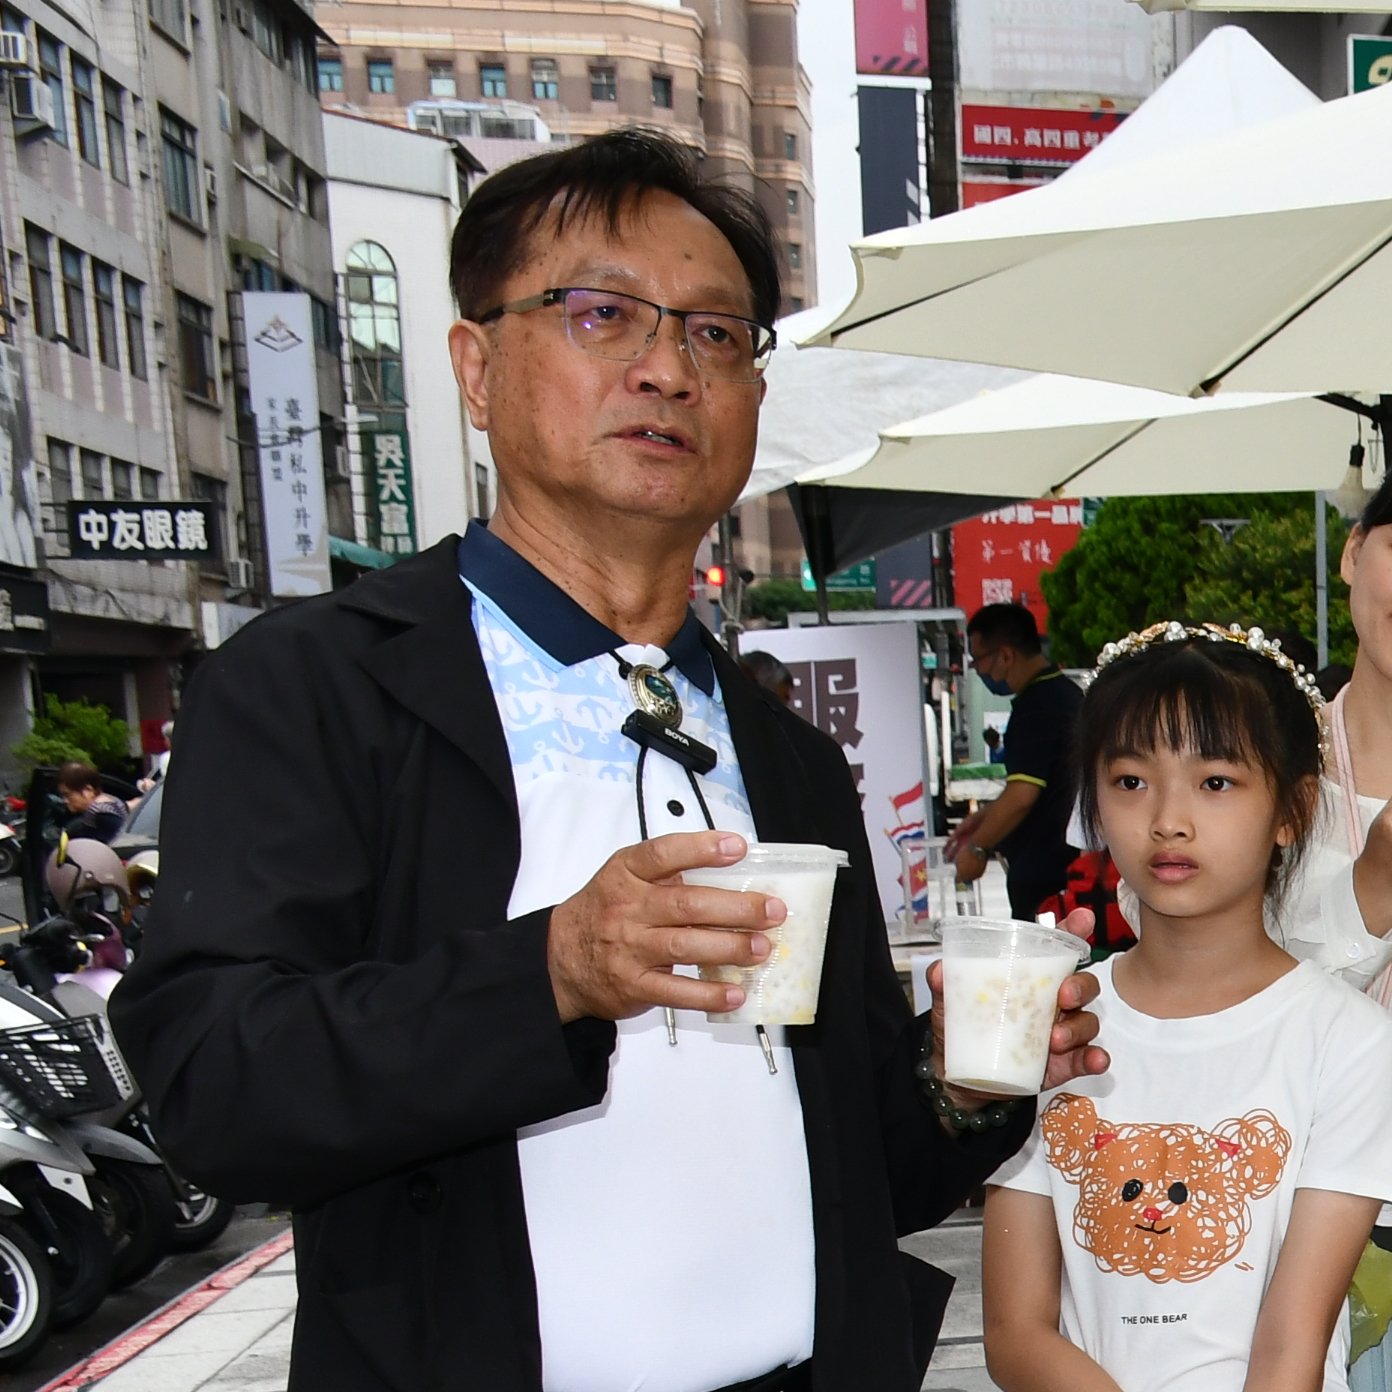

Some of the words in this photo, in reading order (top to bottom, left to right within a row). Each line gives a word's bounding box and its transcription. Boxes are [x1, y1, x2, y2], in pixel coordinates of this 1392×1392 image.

[78, 507, 208, 551] 中友眼鏡
[664, 727, 690, 747] BOYA
[1120, 1316, 1138, 1325] THE
[1139, 1315, 1160, 1325] ONE
[1161, 1312, 1188, 1324] BEAR
